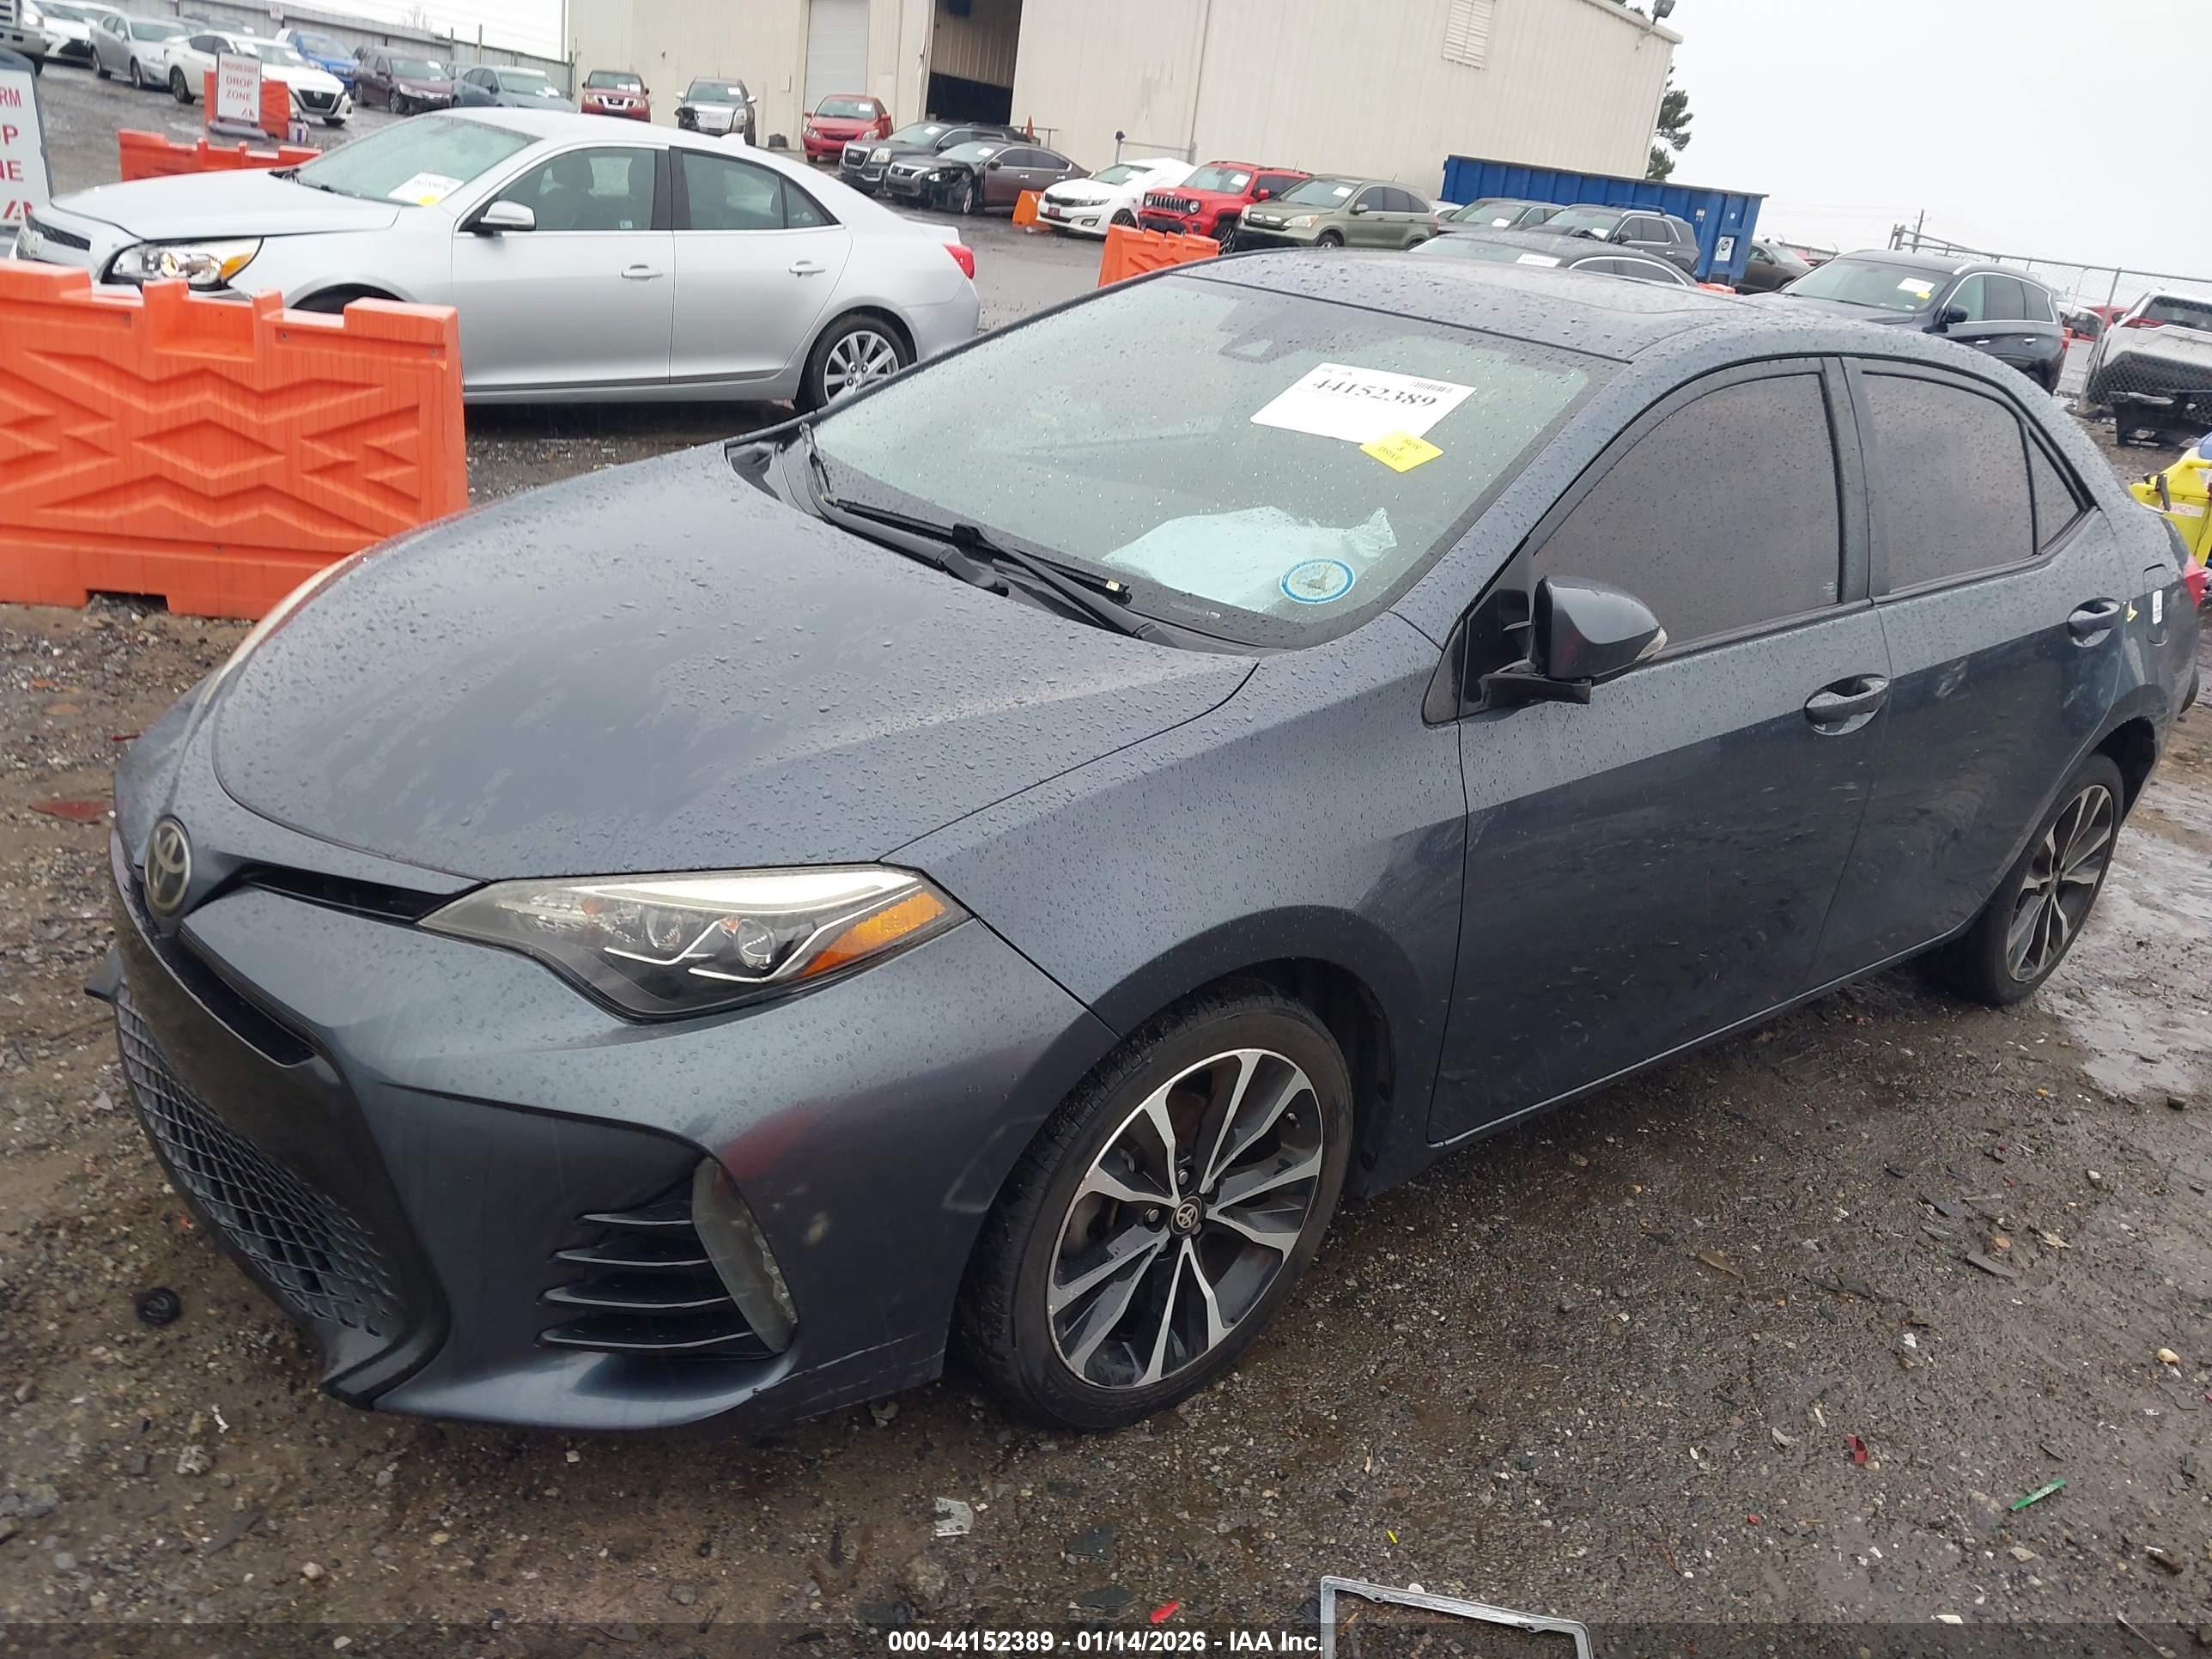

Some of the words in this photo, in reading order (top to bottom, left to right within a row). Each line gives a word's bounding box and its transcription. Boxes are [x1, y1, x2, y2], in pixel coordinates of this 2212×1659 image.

[226, 75, 253, 88] DROP
[226, 90, 251, 103] ZONE
[0, 124, 19, 145] P
[1313, 379, 1437, 407] 44152389
